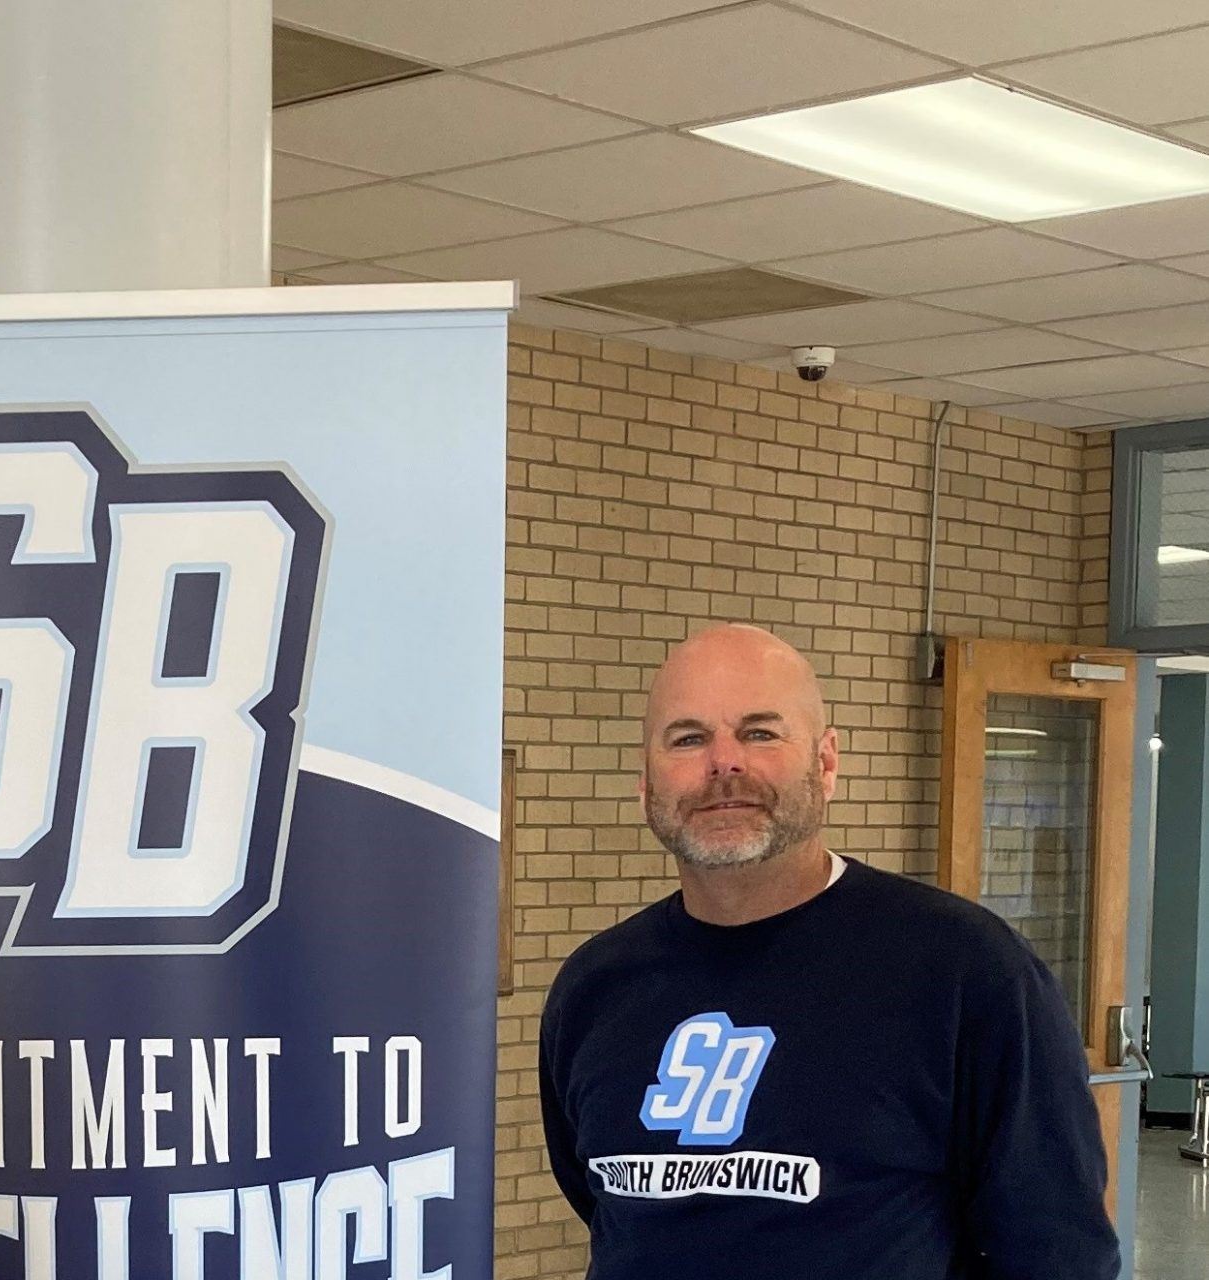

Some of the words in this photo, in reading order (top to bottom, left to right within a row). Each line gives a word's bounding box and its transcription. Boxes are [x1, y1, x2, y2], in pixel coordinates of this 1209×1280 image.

[332, 1036, 422, 1147] TO
[648, 1021, 766, 1135] SB
[595, 1161, 654, 1193] SOUTH
[661, 1156, 810, 1197] BRUNSWICK
